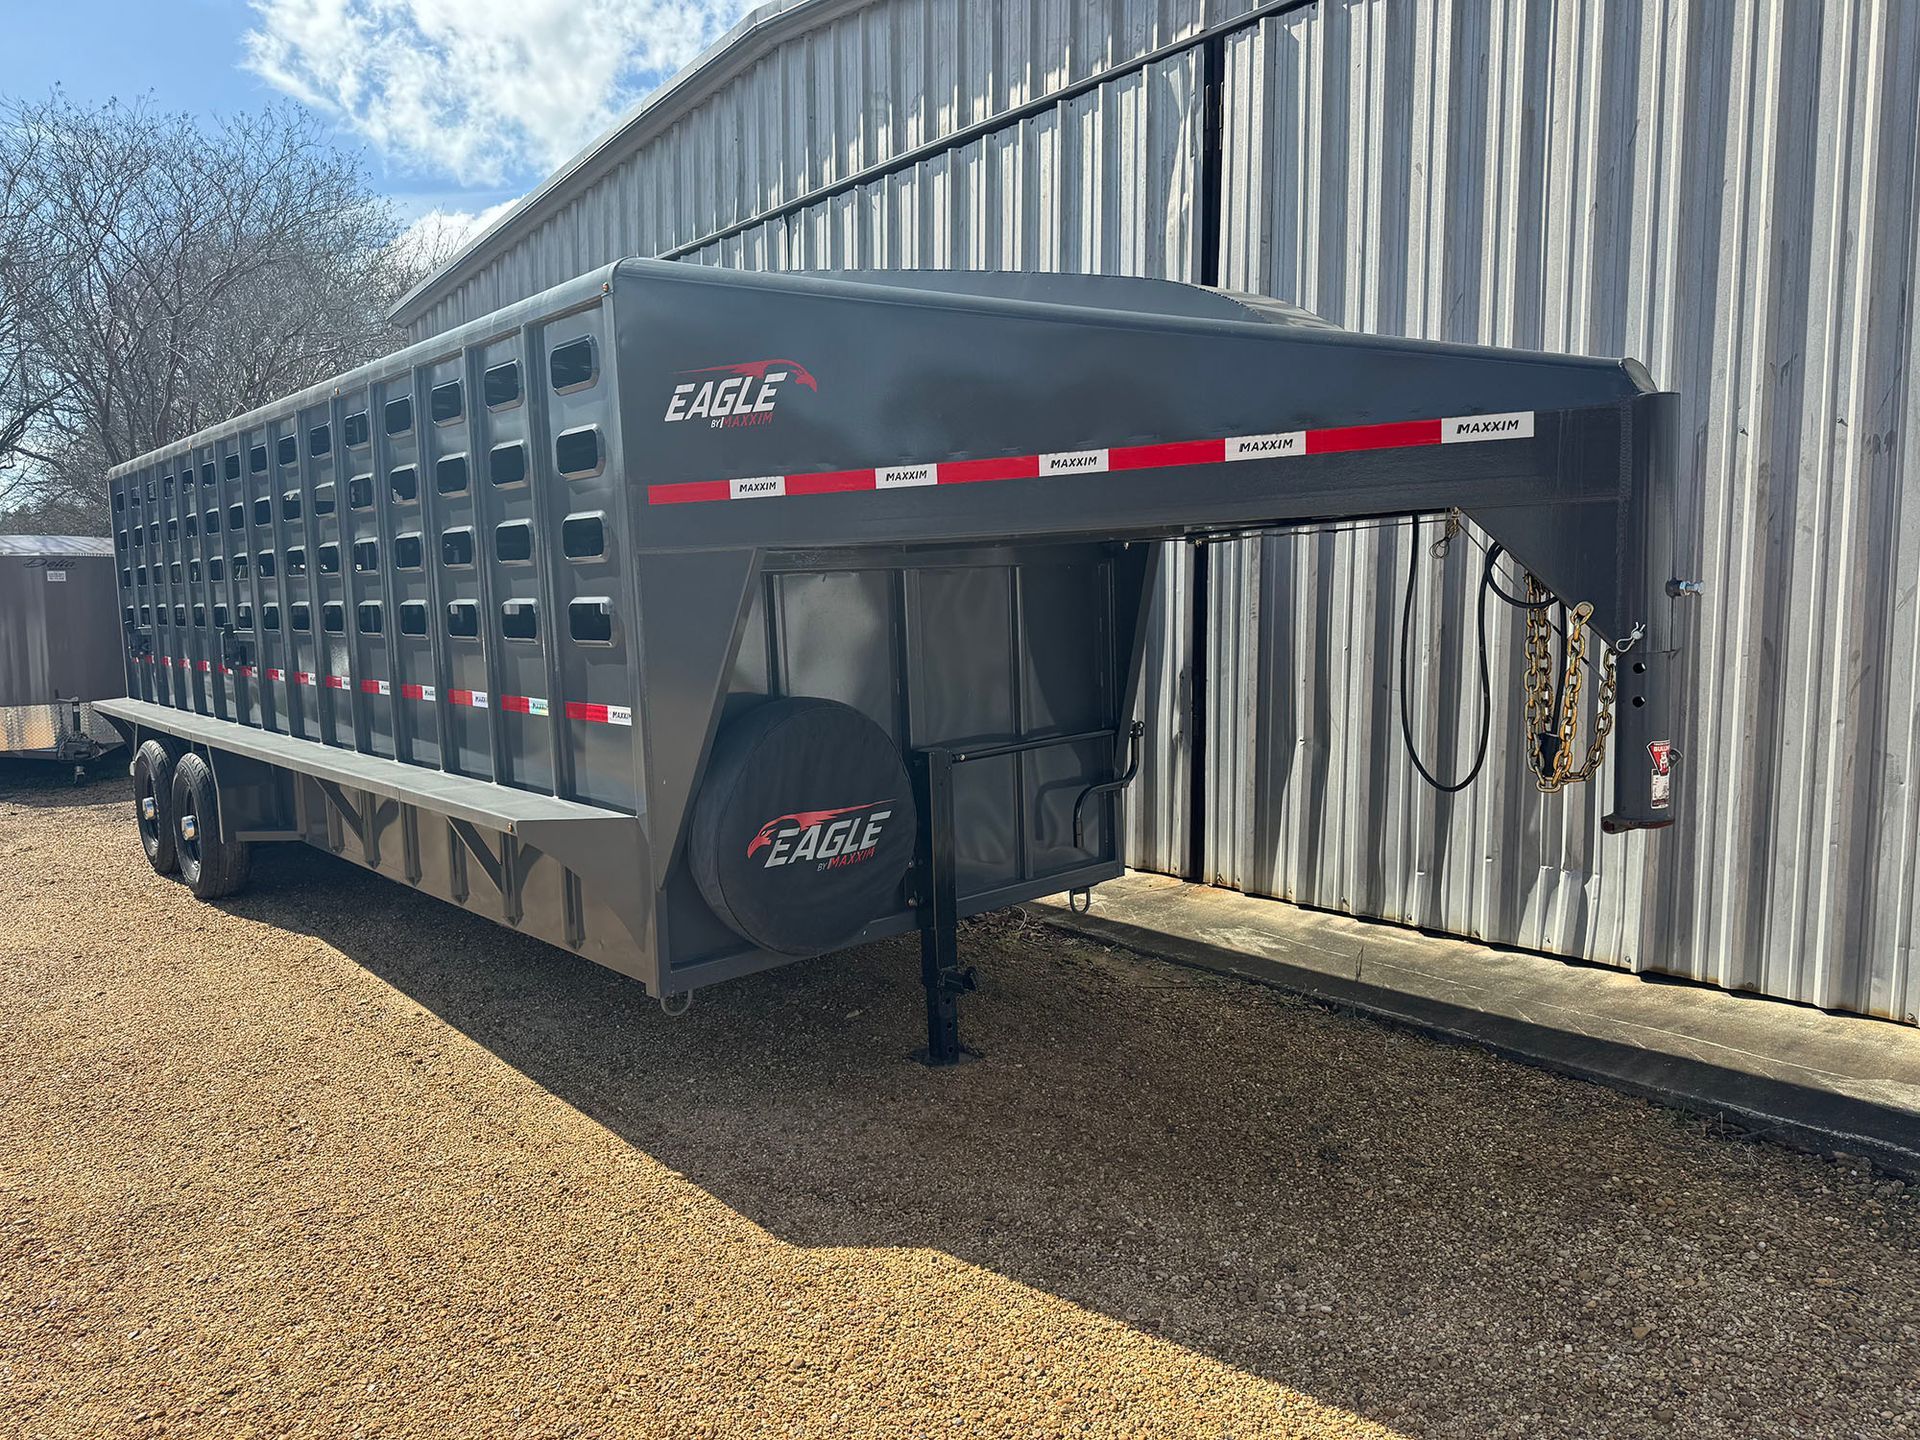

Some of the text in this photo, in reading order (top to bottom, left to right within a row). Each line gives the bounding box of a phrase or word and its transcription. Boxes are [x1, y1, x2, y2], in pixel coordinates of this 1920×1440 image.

[664, 371, 788, 422] EAGLE
[711, 412, 774, 428] BY MAXXIM
[739, 420, 1520, 493] MAXXIM MAXXIM MAXXIM MAXXIM MAXXIM
[24, 557, 76, 568] Delta
[764, 810, 892, 869] EAGLE
[817, 847, 875, 872] BY MAXXIM
